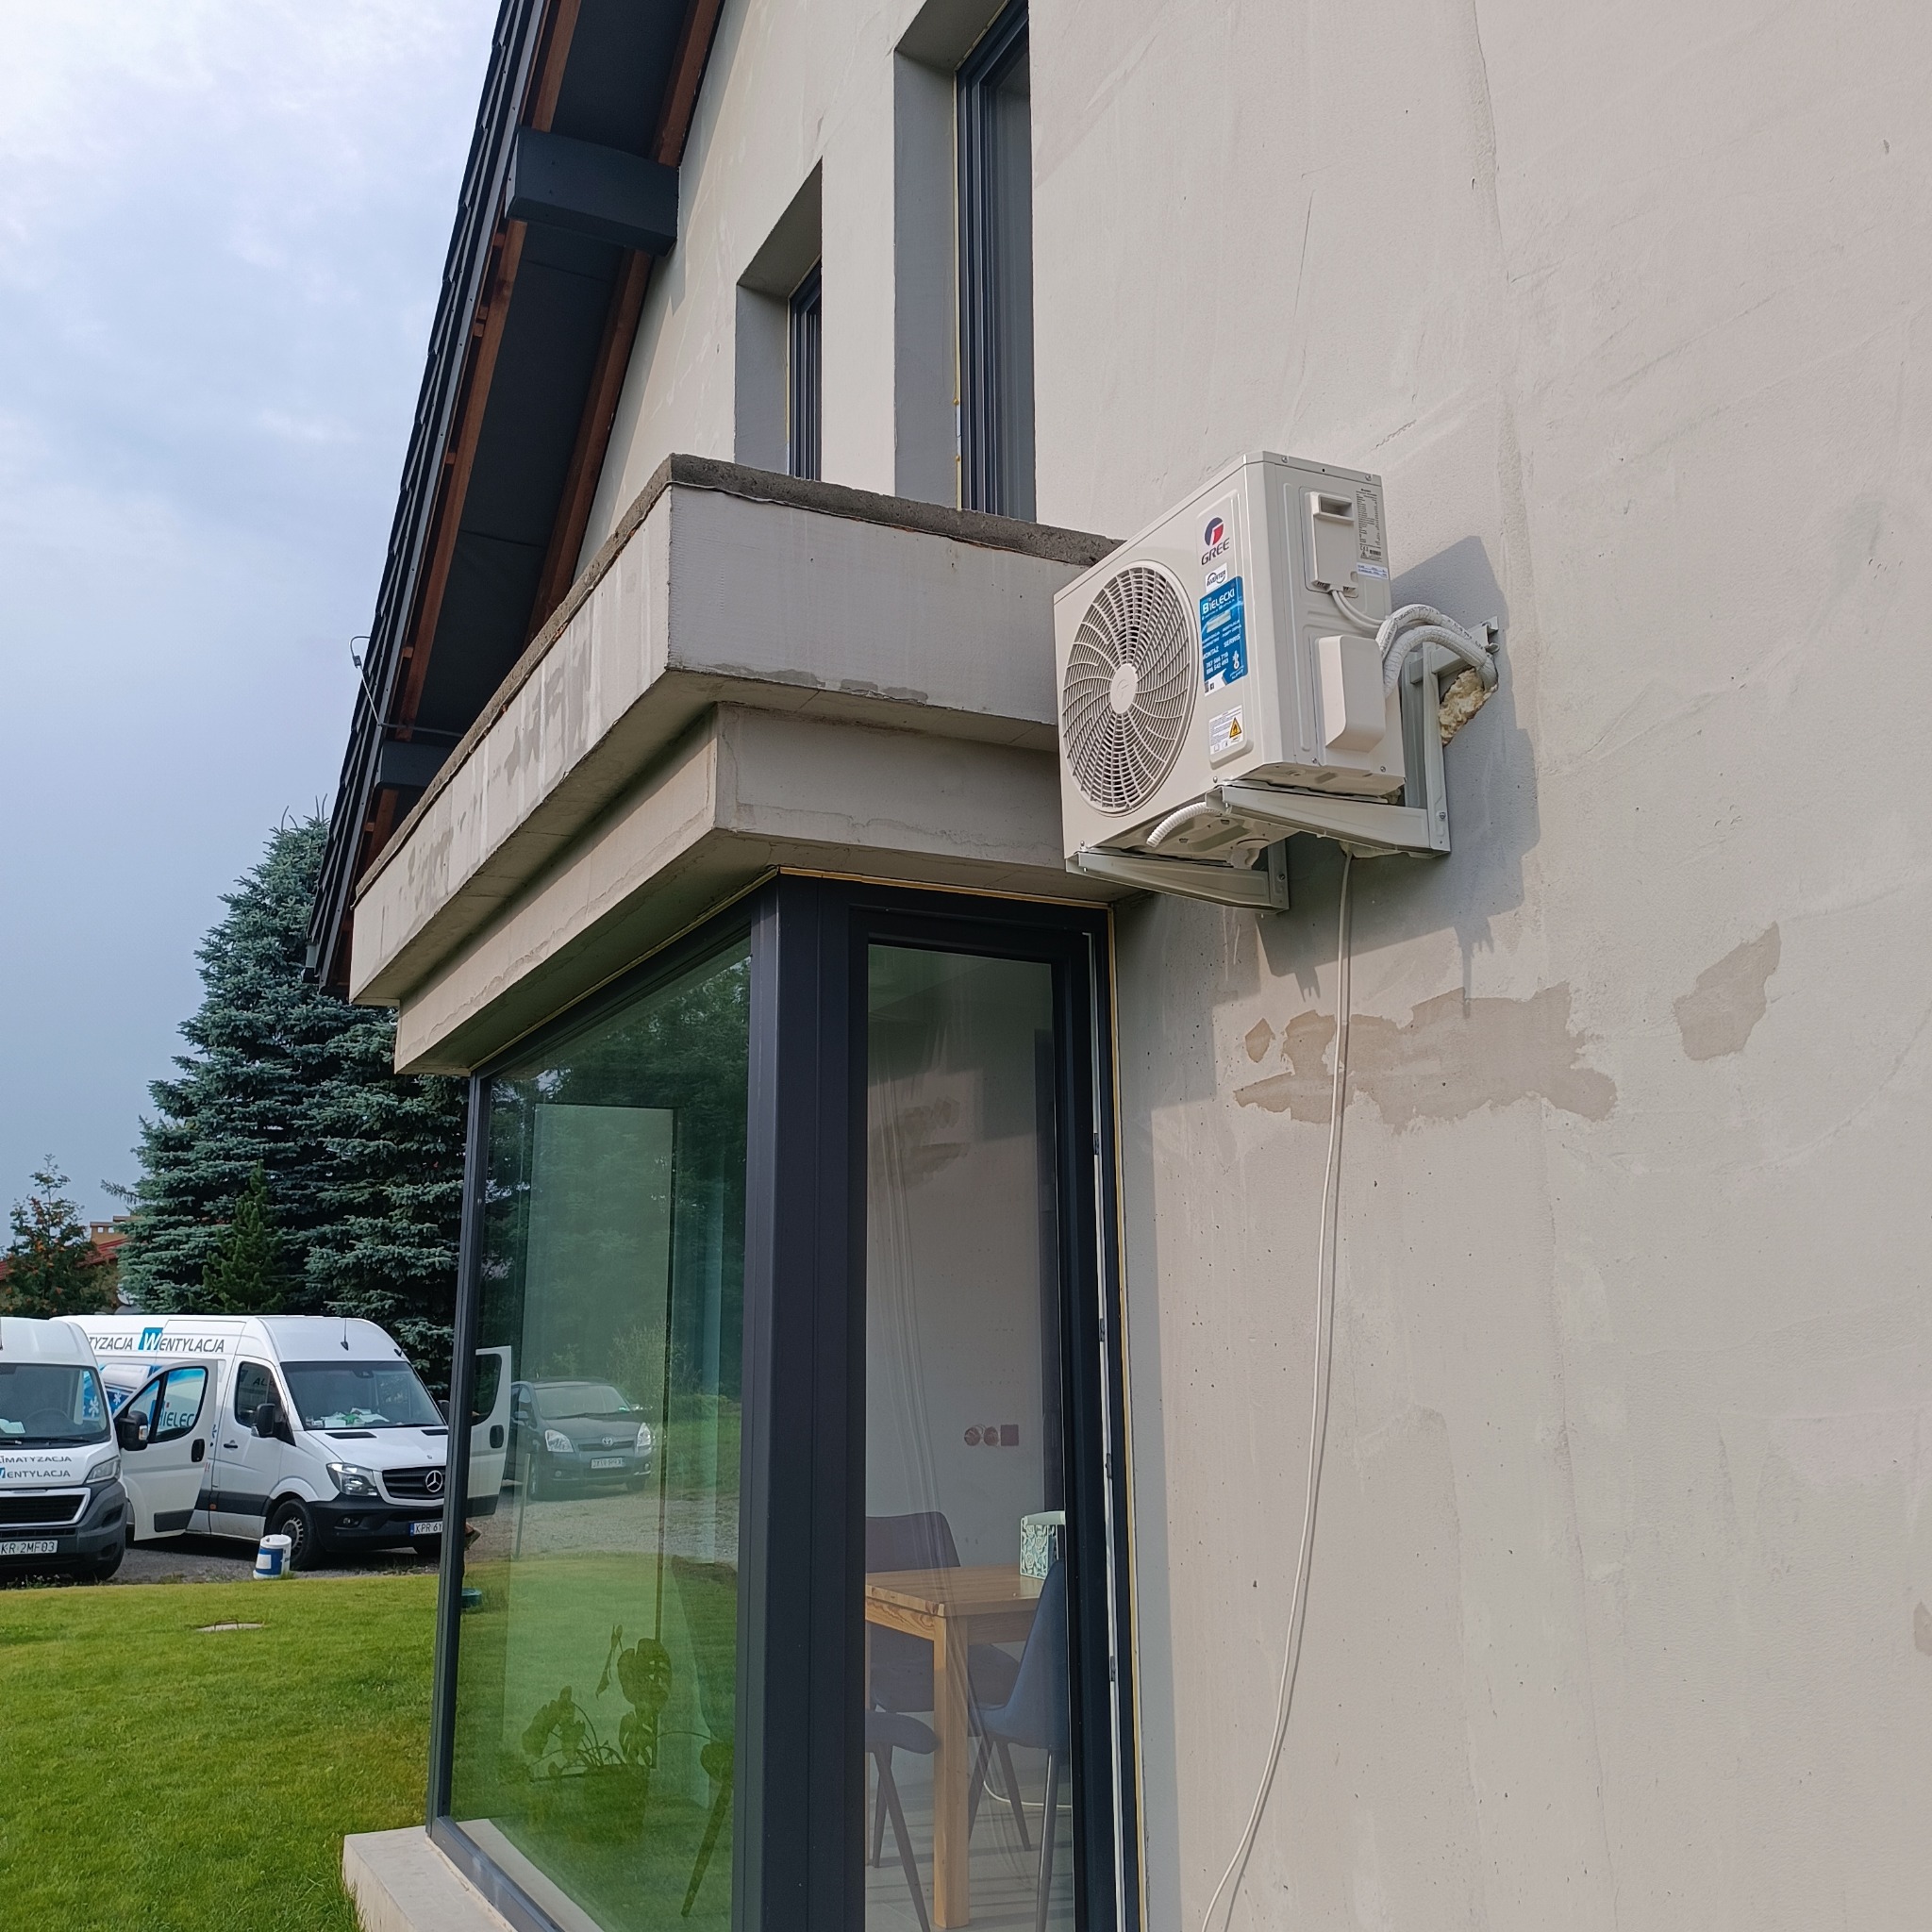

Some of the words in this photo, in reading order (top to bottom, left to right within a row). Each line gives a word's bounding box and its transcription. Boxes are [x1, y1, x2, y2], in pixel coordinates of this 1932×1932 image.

[1201, 537, 1230, 566] GREE
[142, 1331, 225, 1353] WENTYLACJA
[415, 1523, 431, 1534] KPR
[1, 1542, 16, 1555] KR
[20, 1541, 55, 1554] 2MF03
